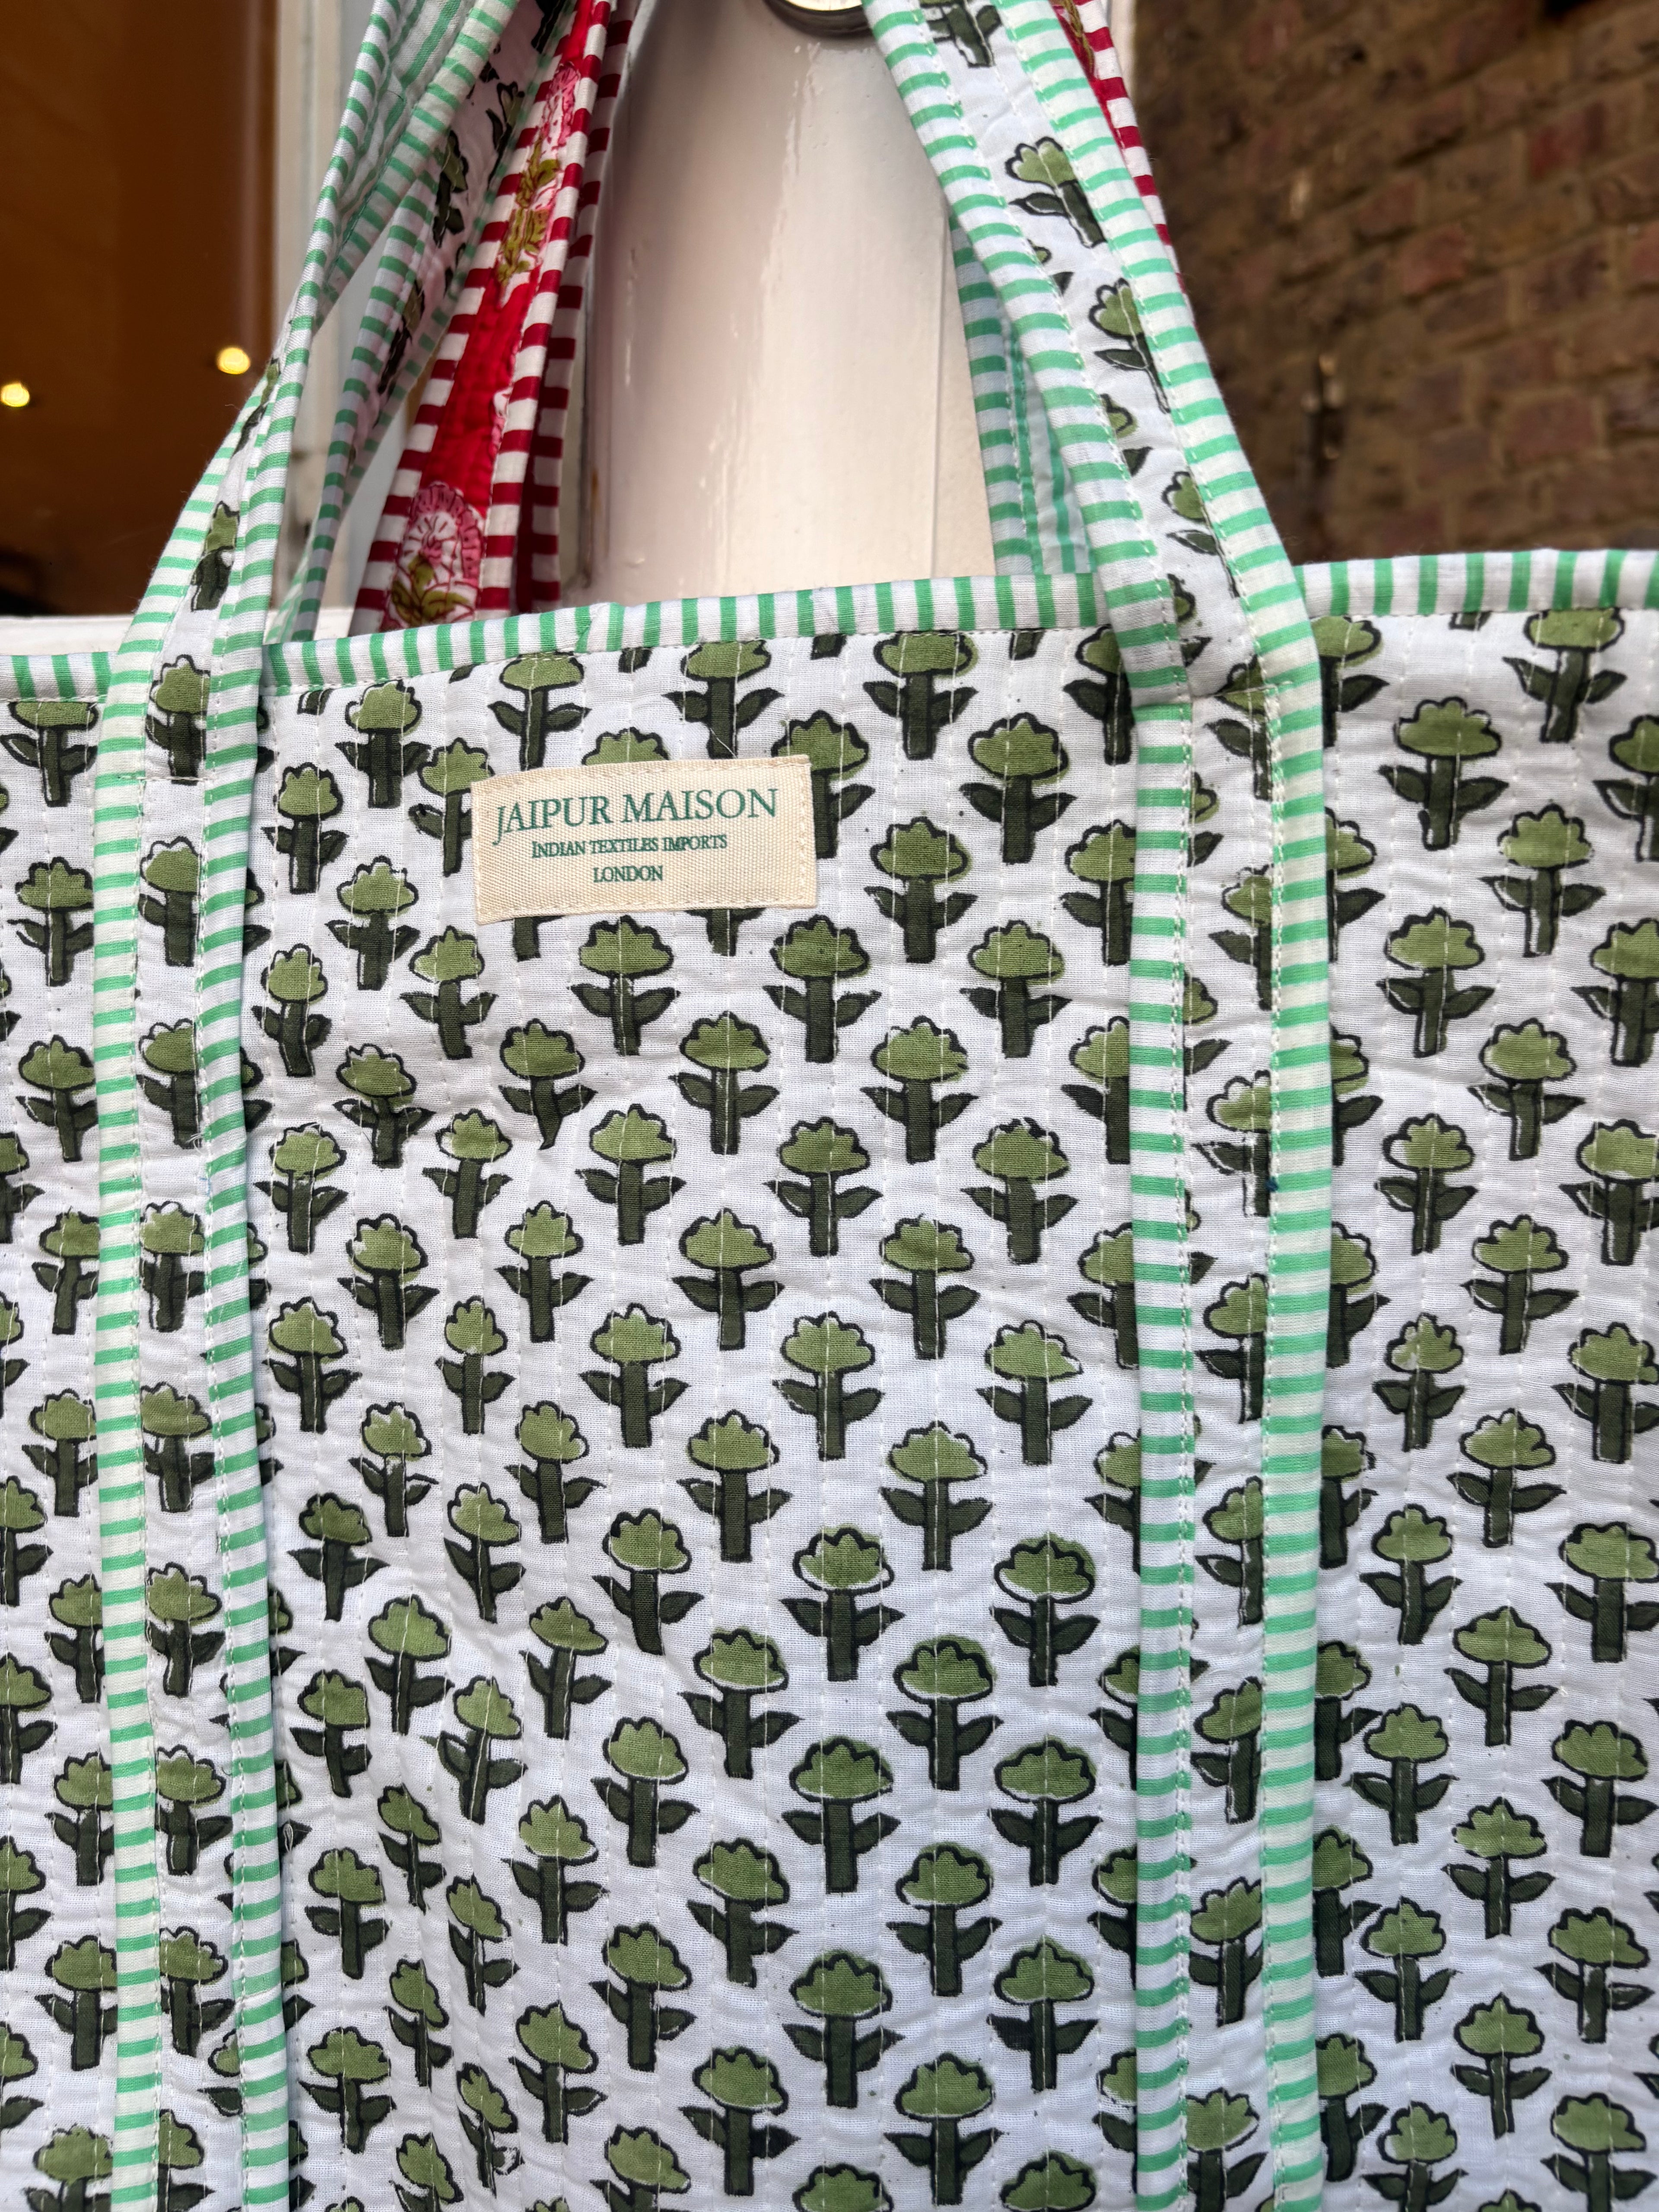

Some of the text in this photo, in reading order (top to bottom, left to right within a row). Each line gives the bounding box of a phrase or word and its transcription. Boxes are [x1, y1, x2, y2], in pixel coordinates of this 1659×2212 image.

[493, 788, 779, 845] JAIPUR MAISON
[532, 834, 727, 858] INDIAN TEXTILES IMPORTS
[593, 865, 663, 884] LONDON
